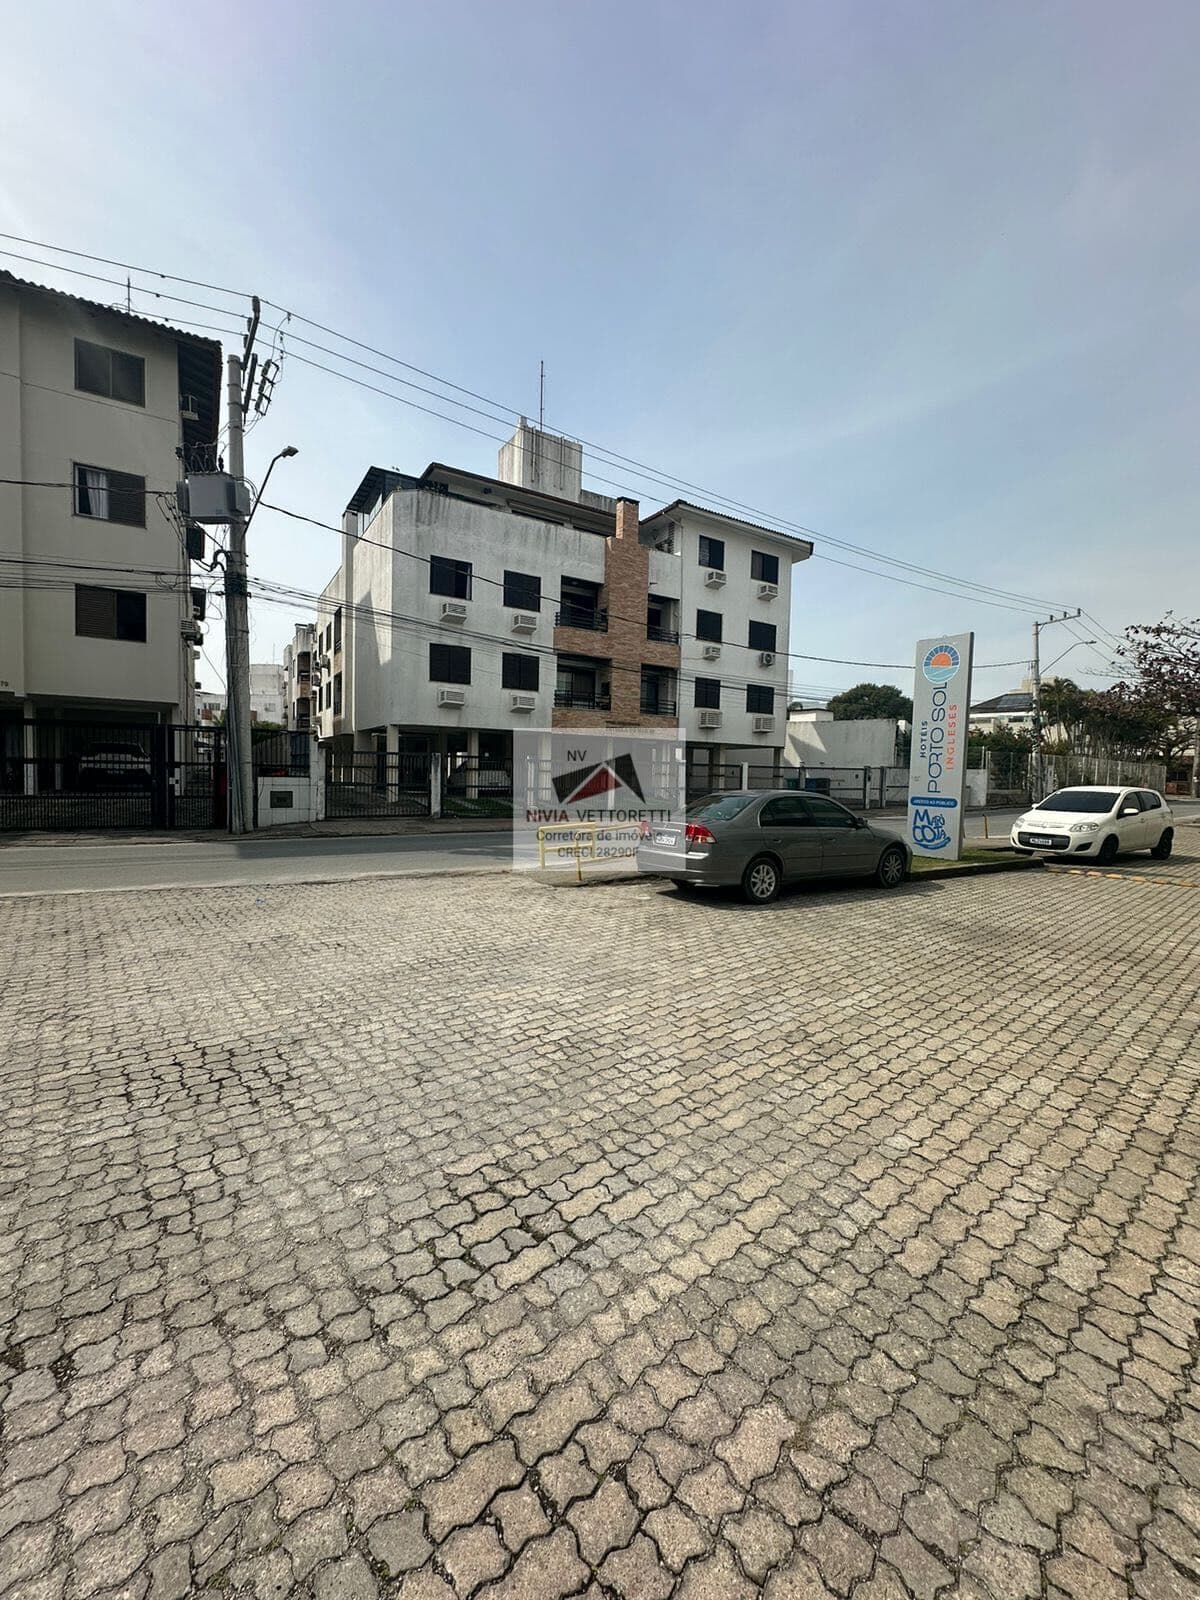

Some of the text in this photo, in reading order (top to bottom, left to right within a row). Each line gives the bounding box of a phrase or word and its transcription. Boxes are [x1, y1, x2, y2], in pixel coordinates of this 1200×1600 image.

[927, 681, 948, 793] PORTO SOL
[946, 704, 958, 770] INGLESES
